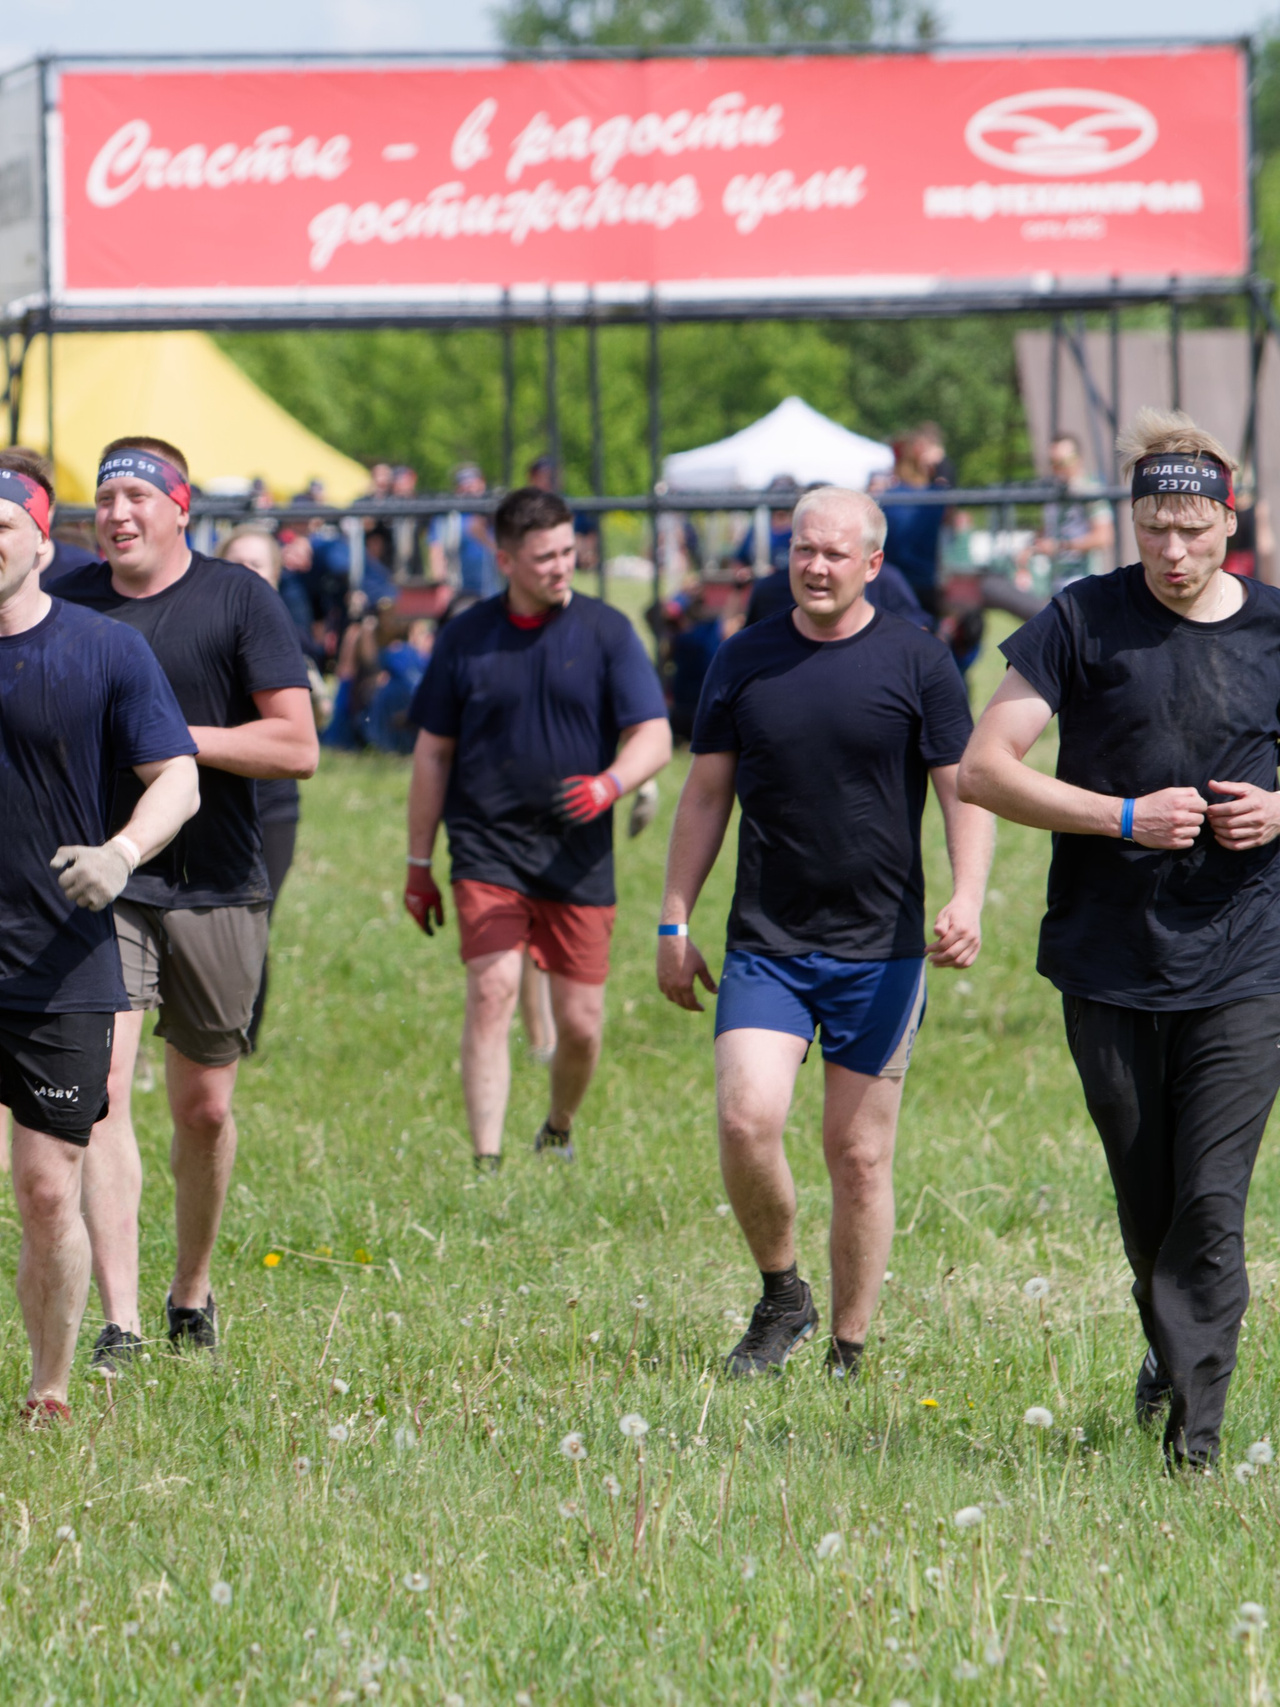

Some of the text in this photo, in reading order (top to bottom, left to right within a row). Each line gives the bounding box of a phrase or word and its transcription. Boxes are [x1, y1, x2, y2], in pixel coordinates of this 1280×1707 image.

[87, 118, 352, 208] Счастье
[505, 91, 784, 184] радости
[307, 164, 868, 272] достижения цели
[137, 460, 156, 474] 59
[1142, 464, 1218, 480] РОДЕО 59
[1158, 479, 1201, 492] 2370
